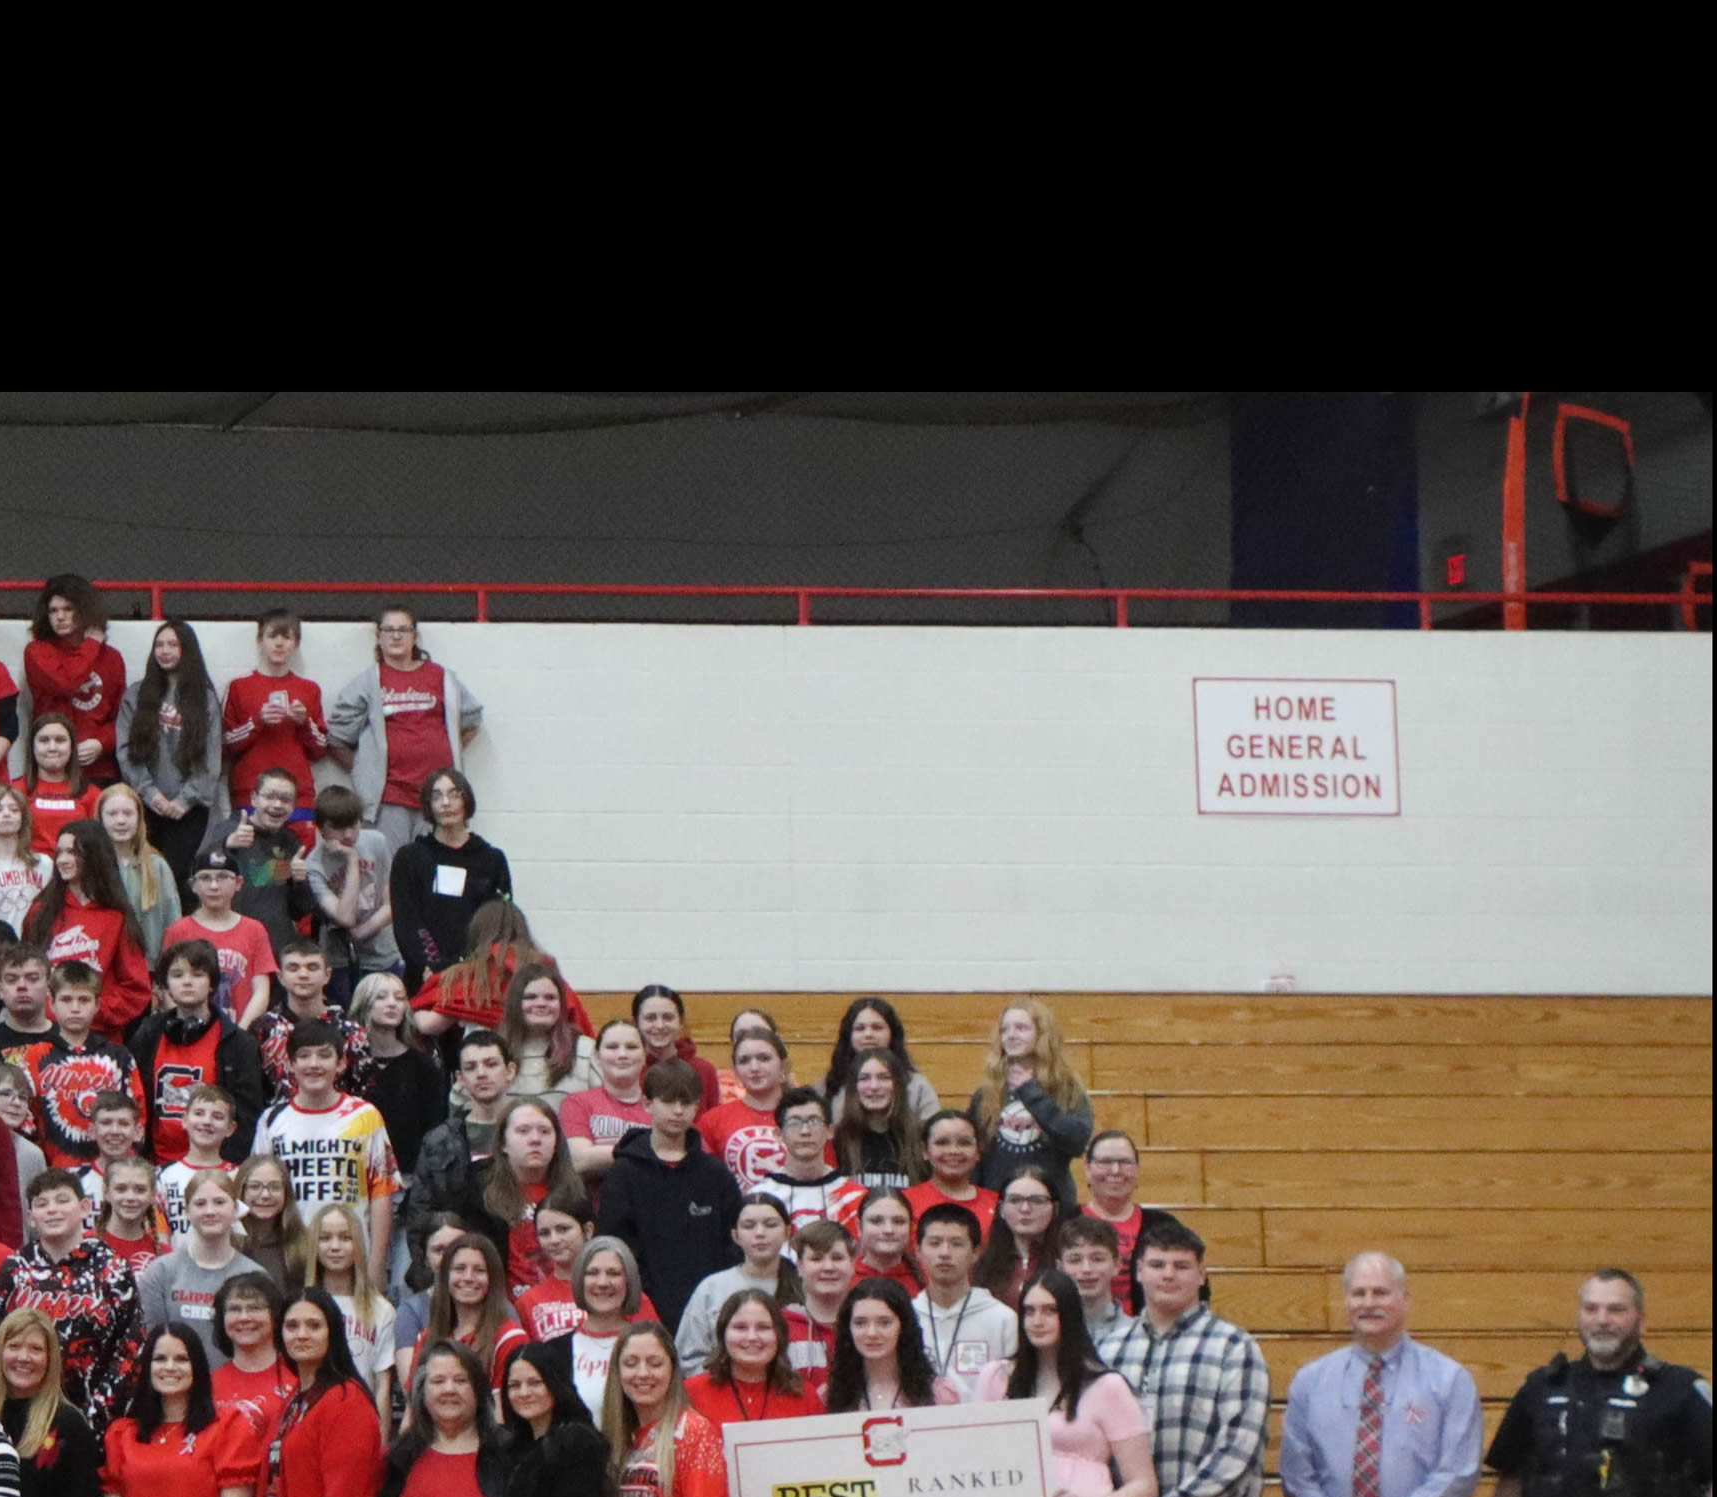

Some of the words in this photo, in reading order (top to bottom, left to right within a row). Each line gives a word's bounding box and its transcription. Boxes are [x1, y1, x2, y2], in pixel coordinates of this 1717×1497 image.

[1254, 696, 1336, 721] HOME
[1226, 735, 1367, 760] GENERAL
[1217, 773, 1382, 799] ADMISSION
[906, 1468, 1025, 1494] RANKED
